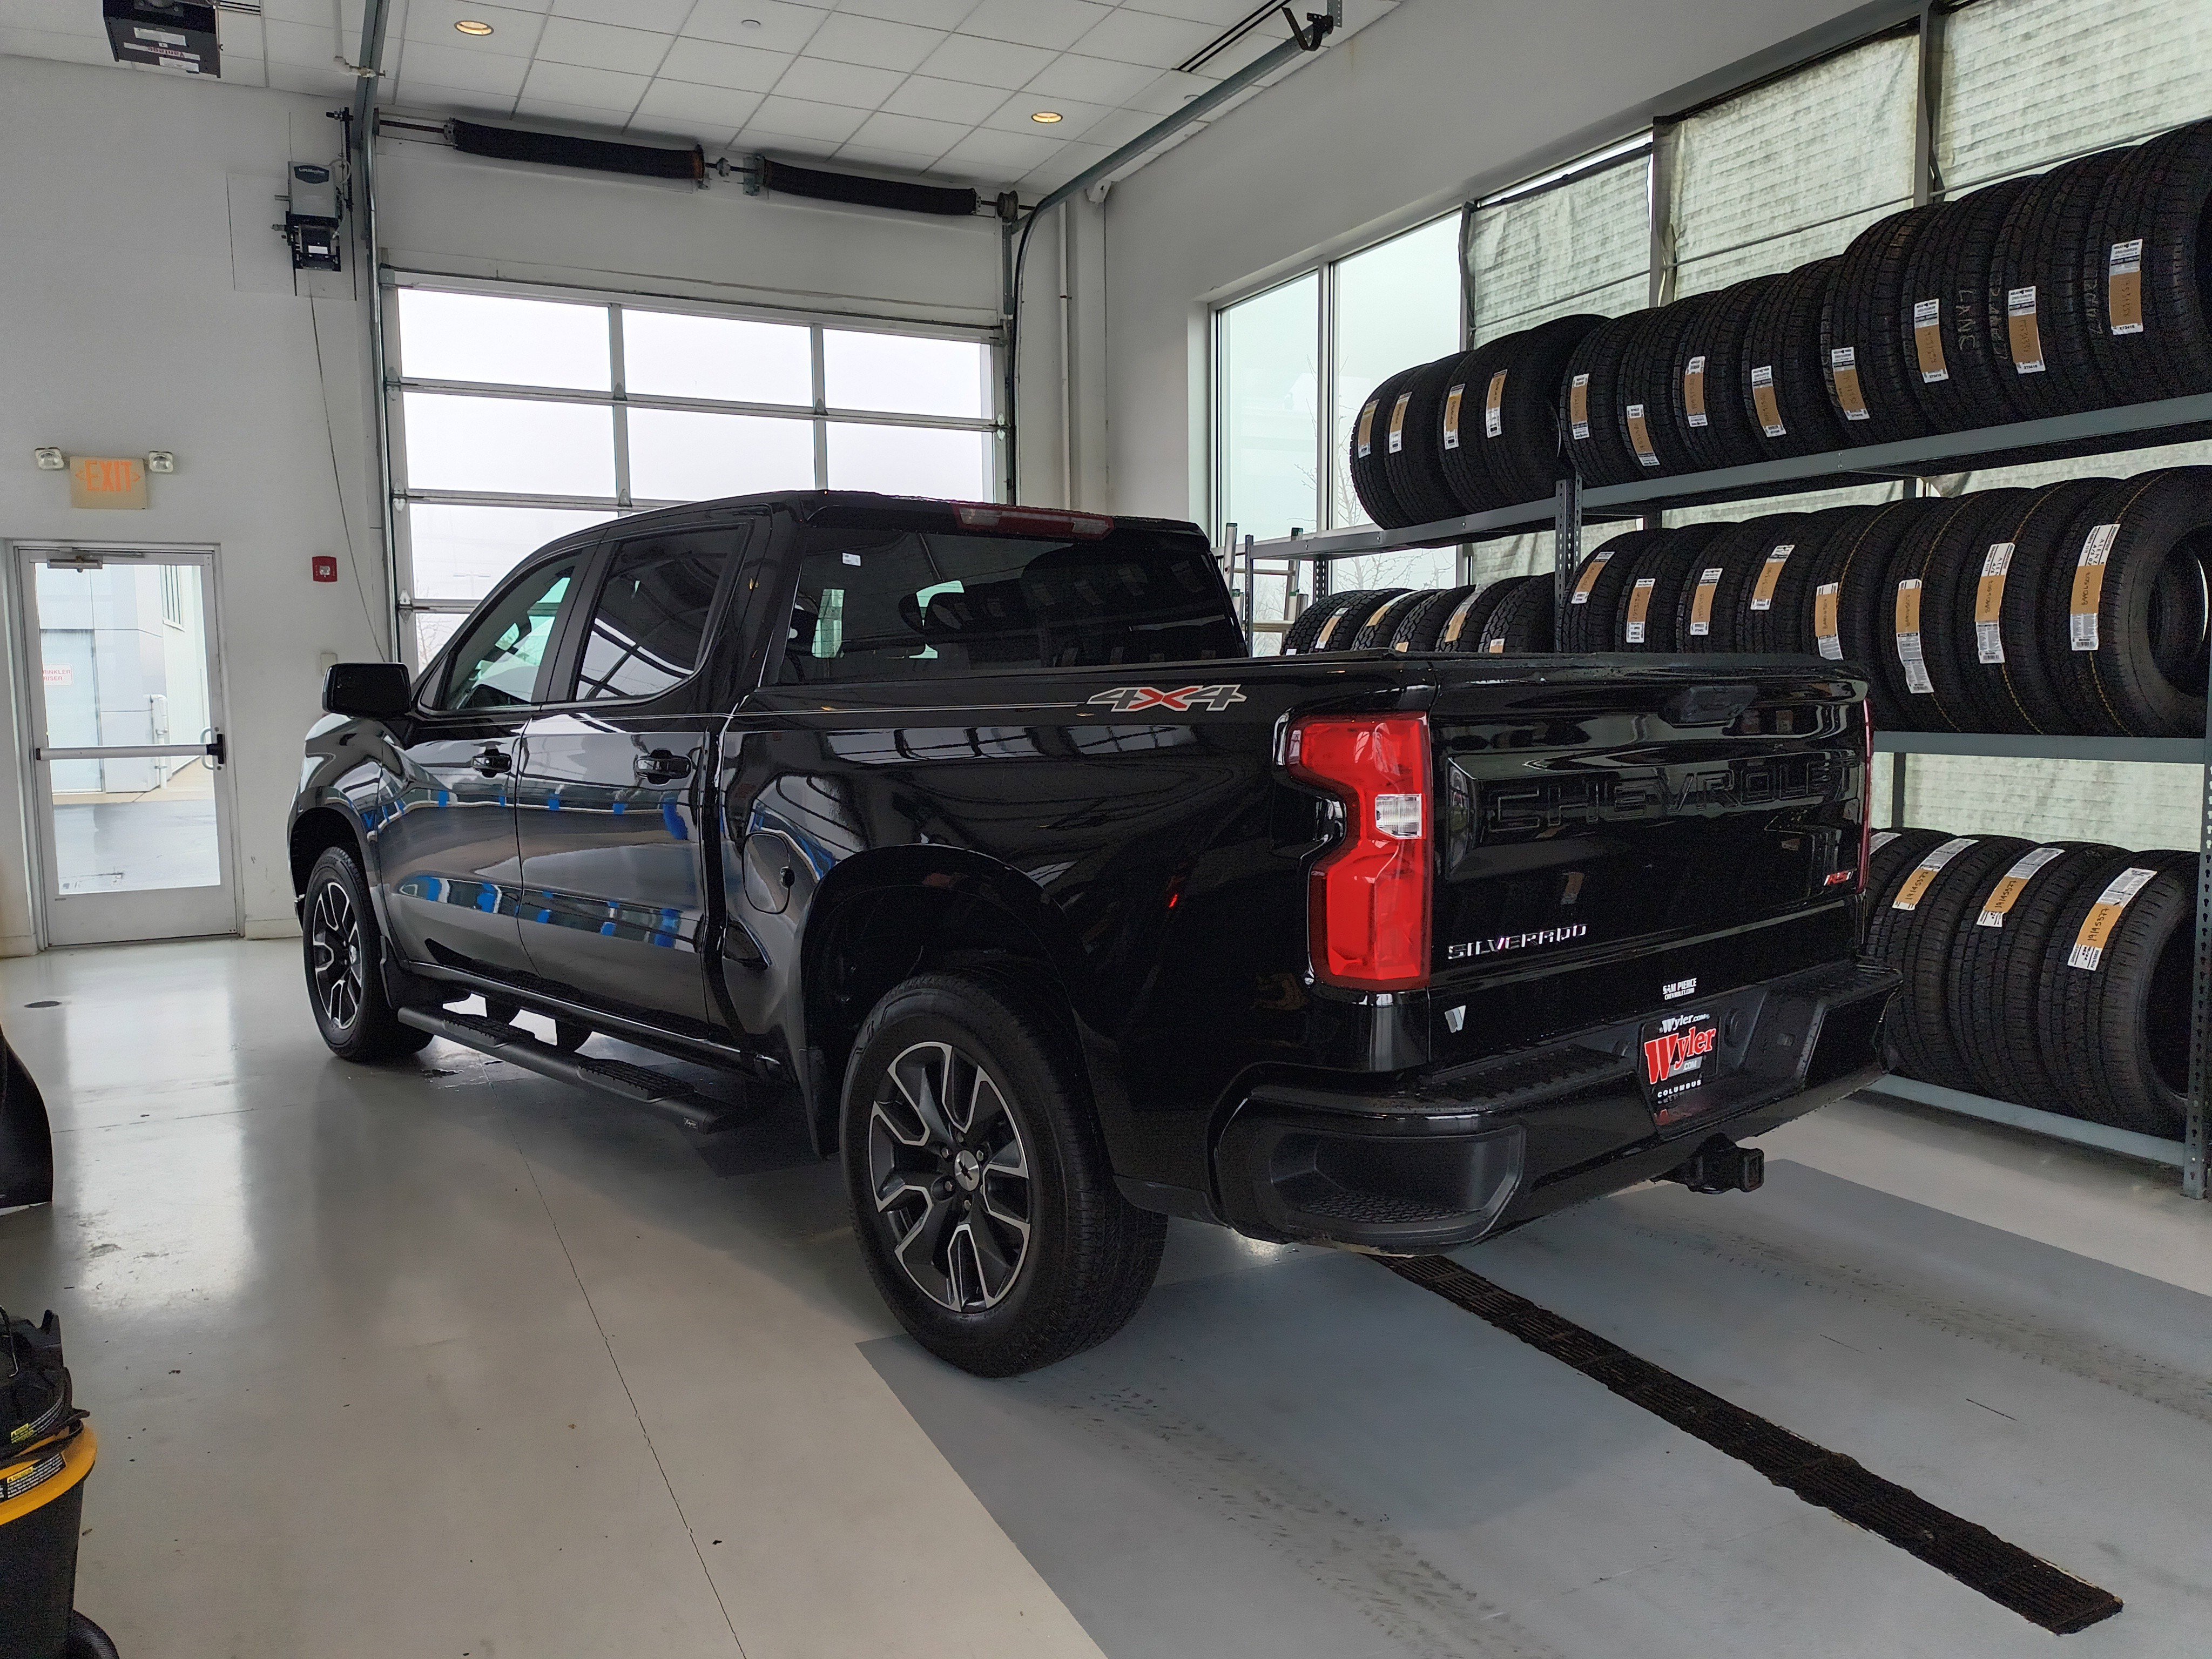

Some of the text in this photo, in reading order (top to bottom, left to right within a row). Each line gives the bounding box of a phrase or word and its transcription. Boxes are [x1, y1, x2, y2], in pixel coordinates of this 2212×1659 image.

[85, 460, 133, 491] EXIT
[2093, 538, 2105, 564] ALENZ
[1448, 923, 1588, 960] SILVERADO
[1663, 977, 1697, 995] SAM PIERCE
[1644, 1026, 1716, 1084] Wyler
[1657, 1080, 1701, 1098] COLUMBUS
